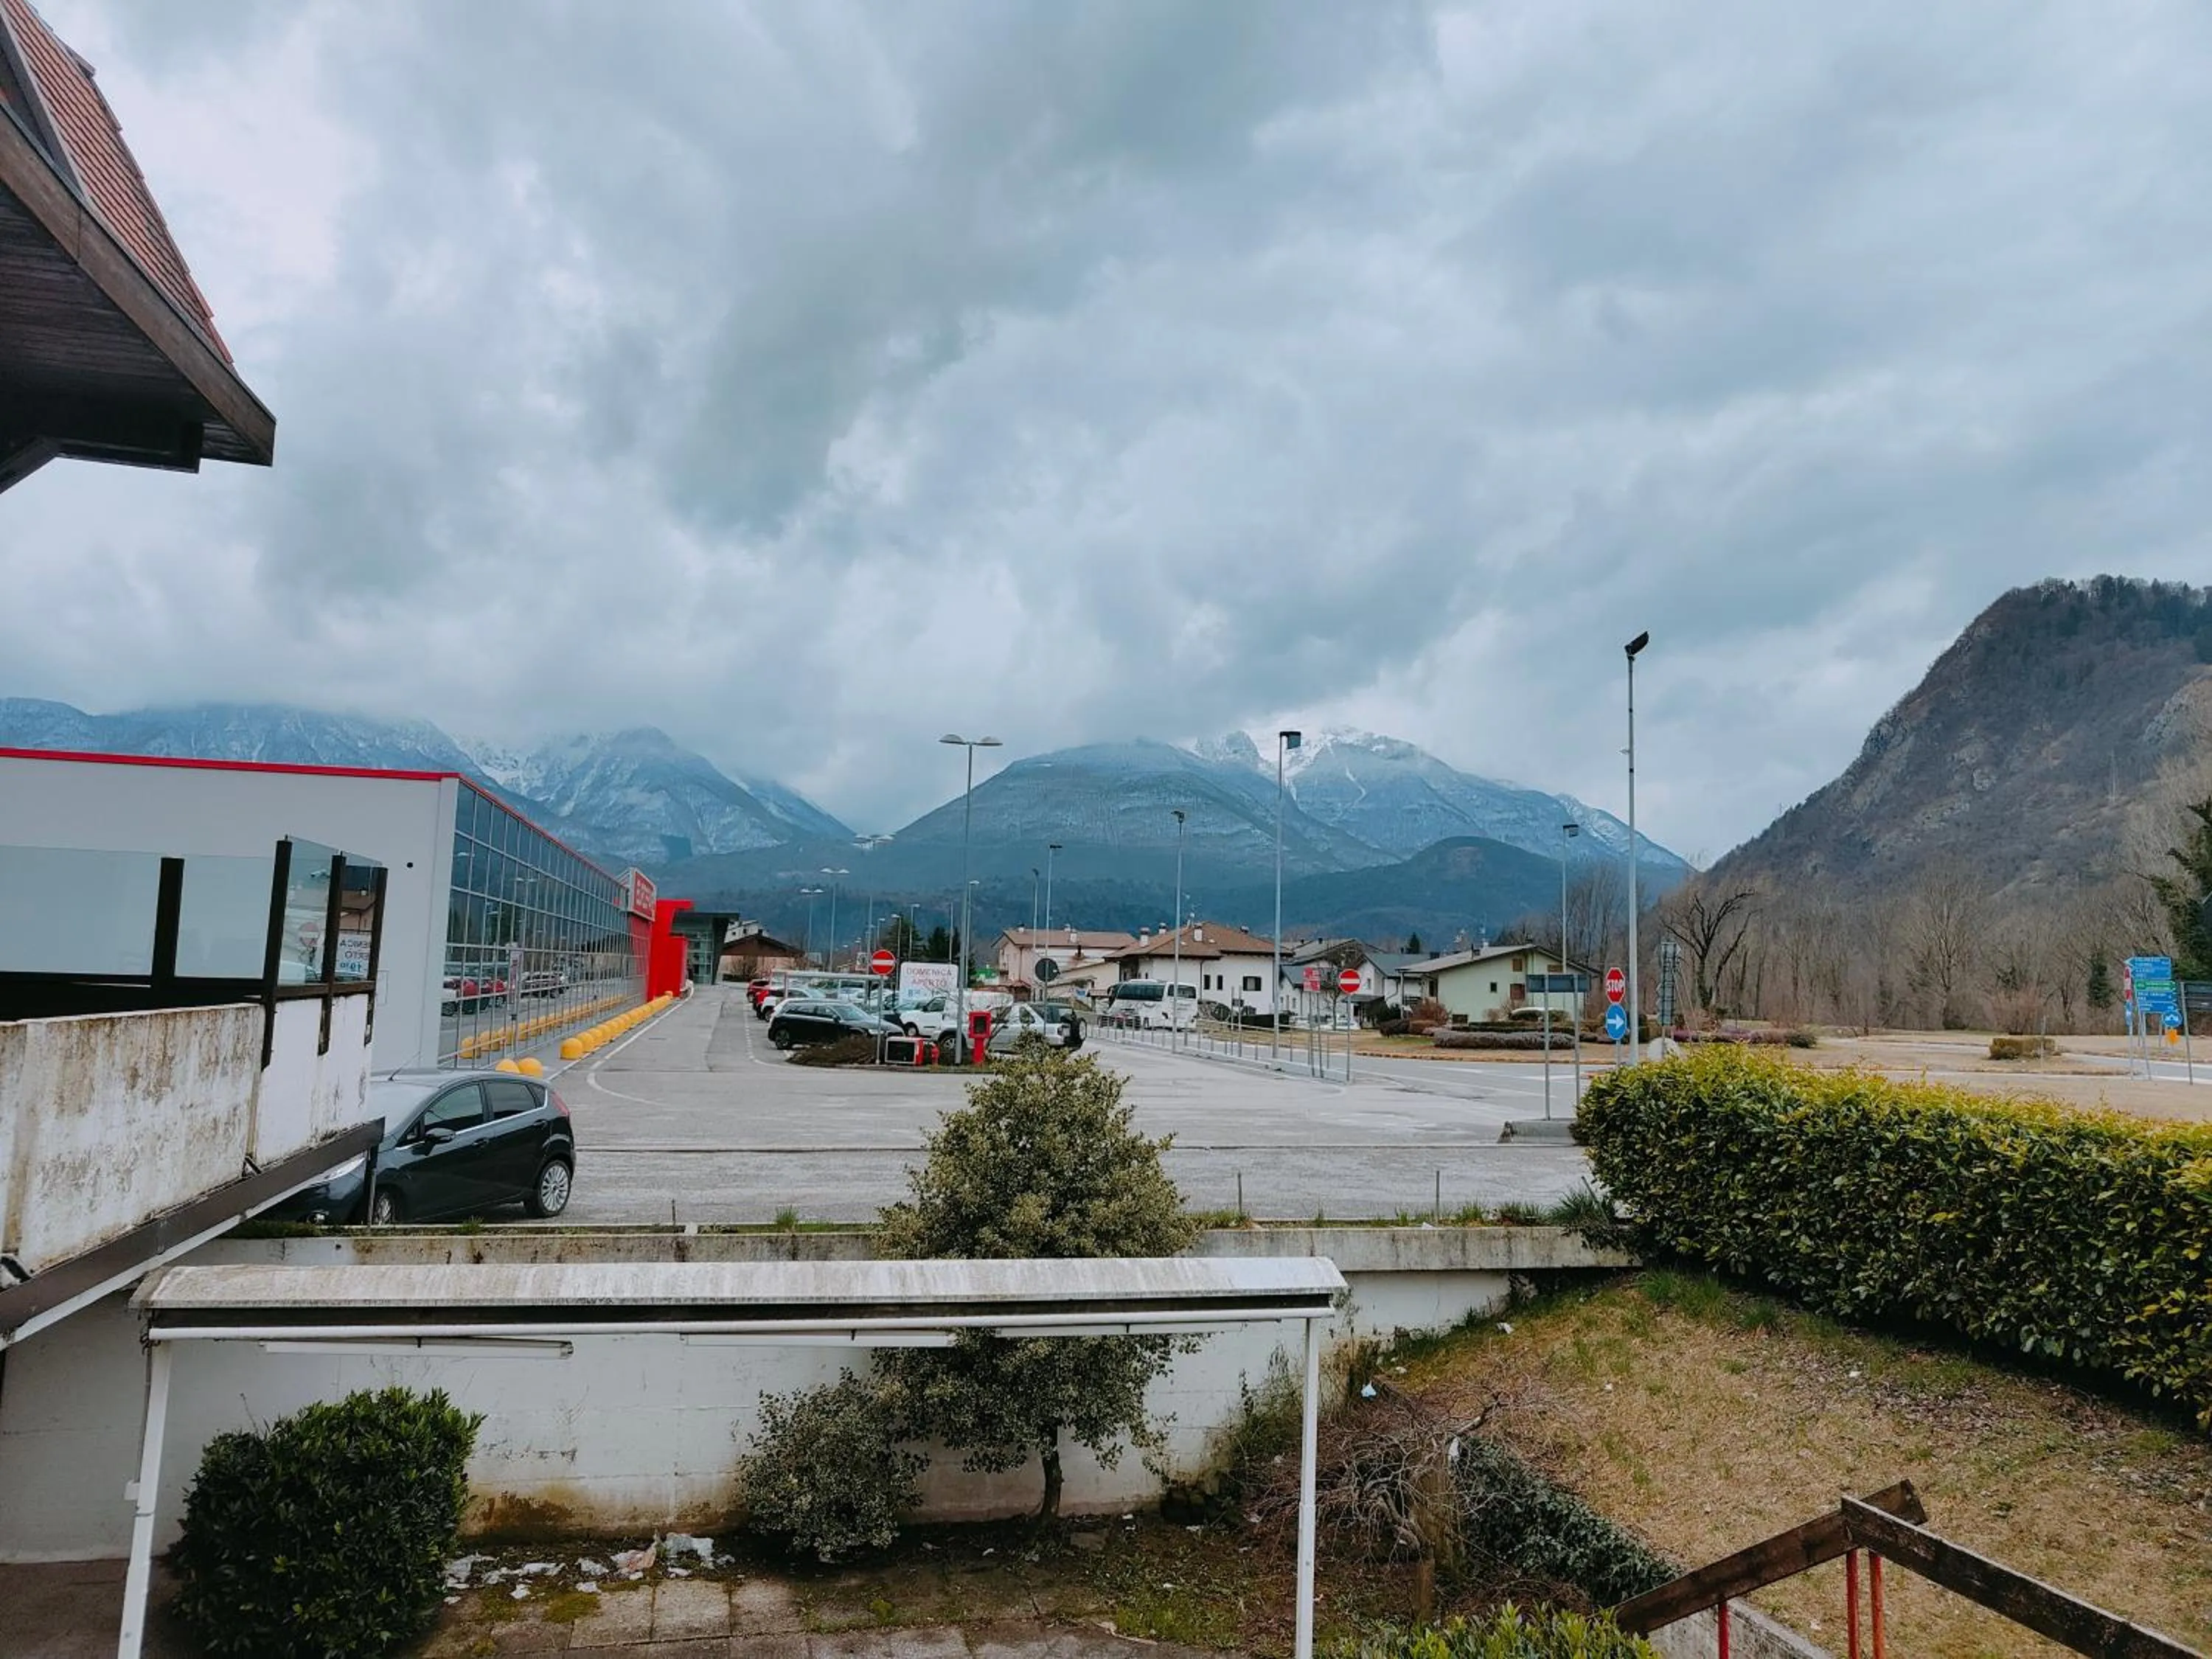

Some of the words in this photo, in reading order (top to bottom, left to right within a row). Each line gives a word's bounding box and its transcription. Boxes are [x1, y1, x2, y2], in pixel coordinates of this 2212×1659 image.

[906, 967, 952, 975] DOMENICA
[913, 977, 947, 987] APERTO
[1606, 979, 1625, 992] STOP
